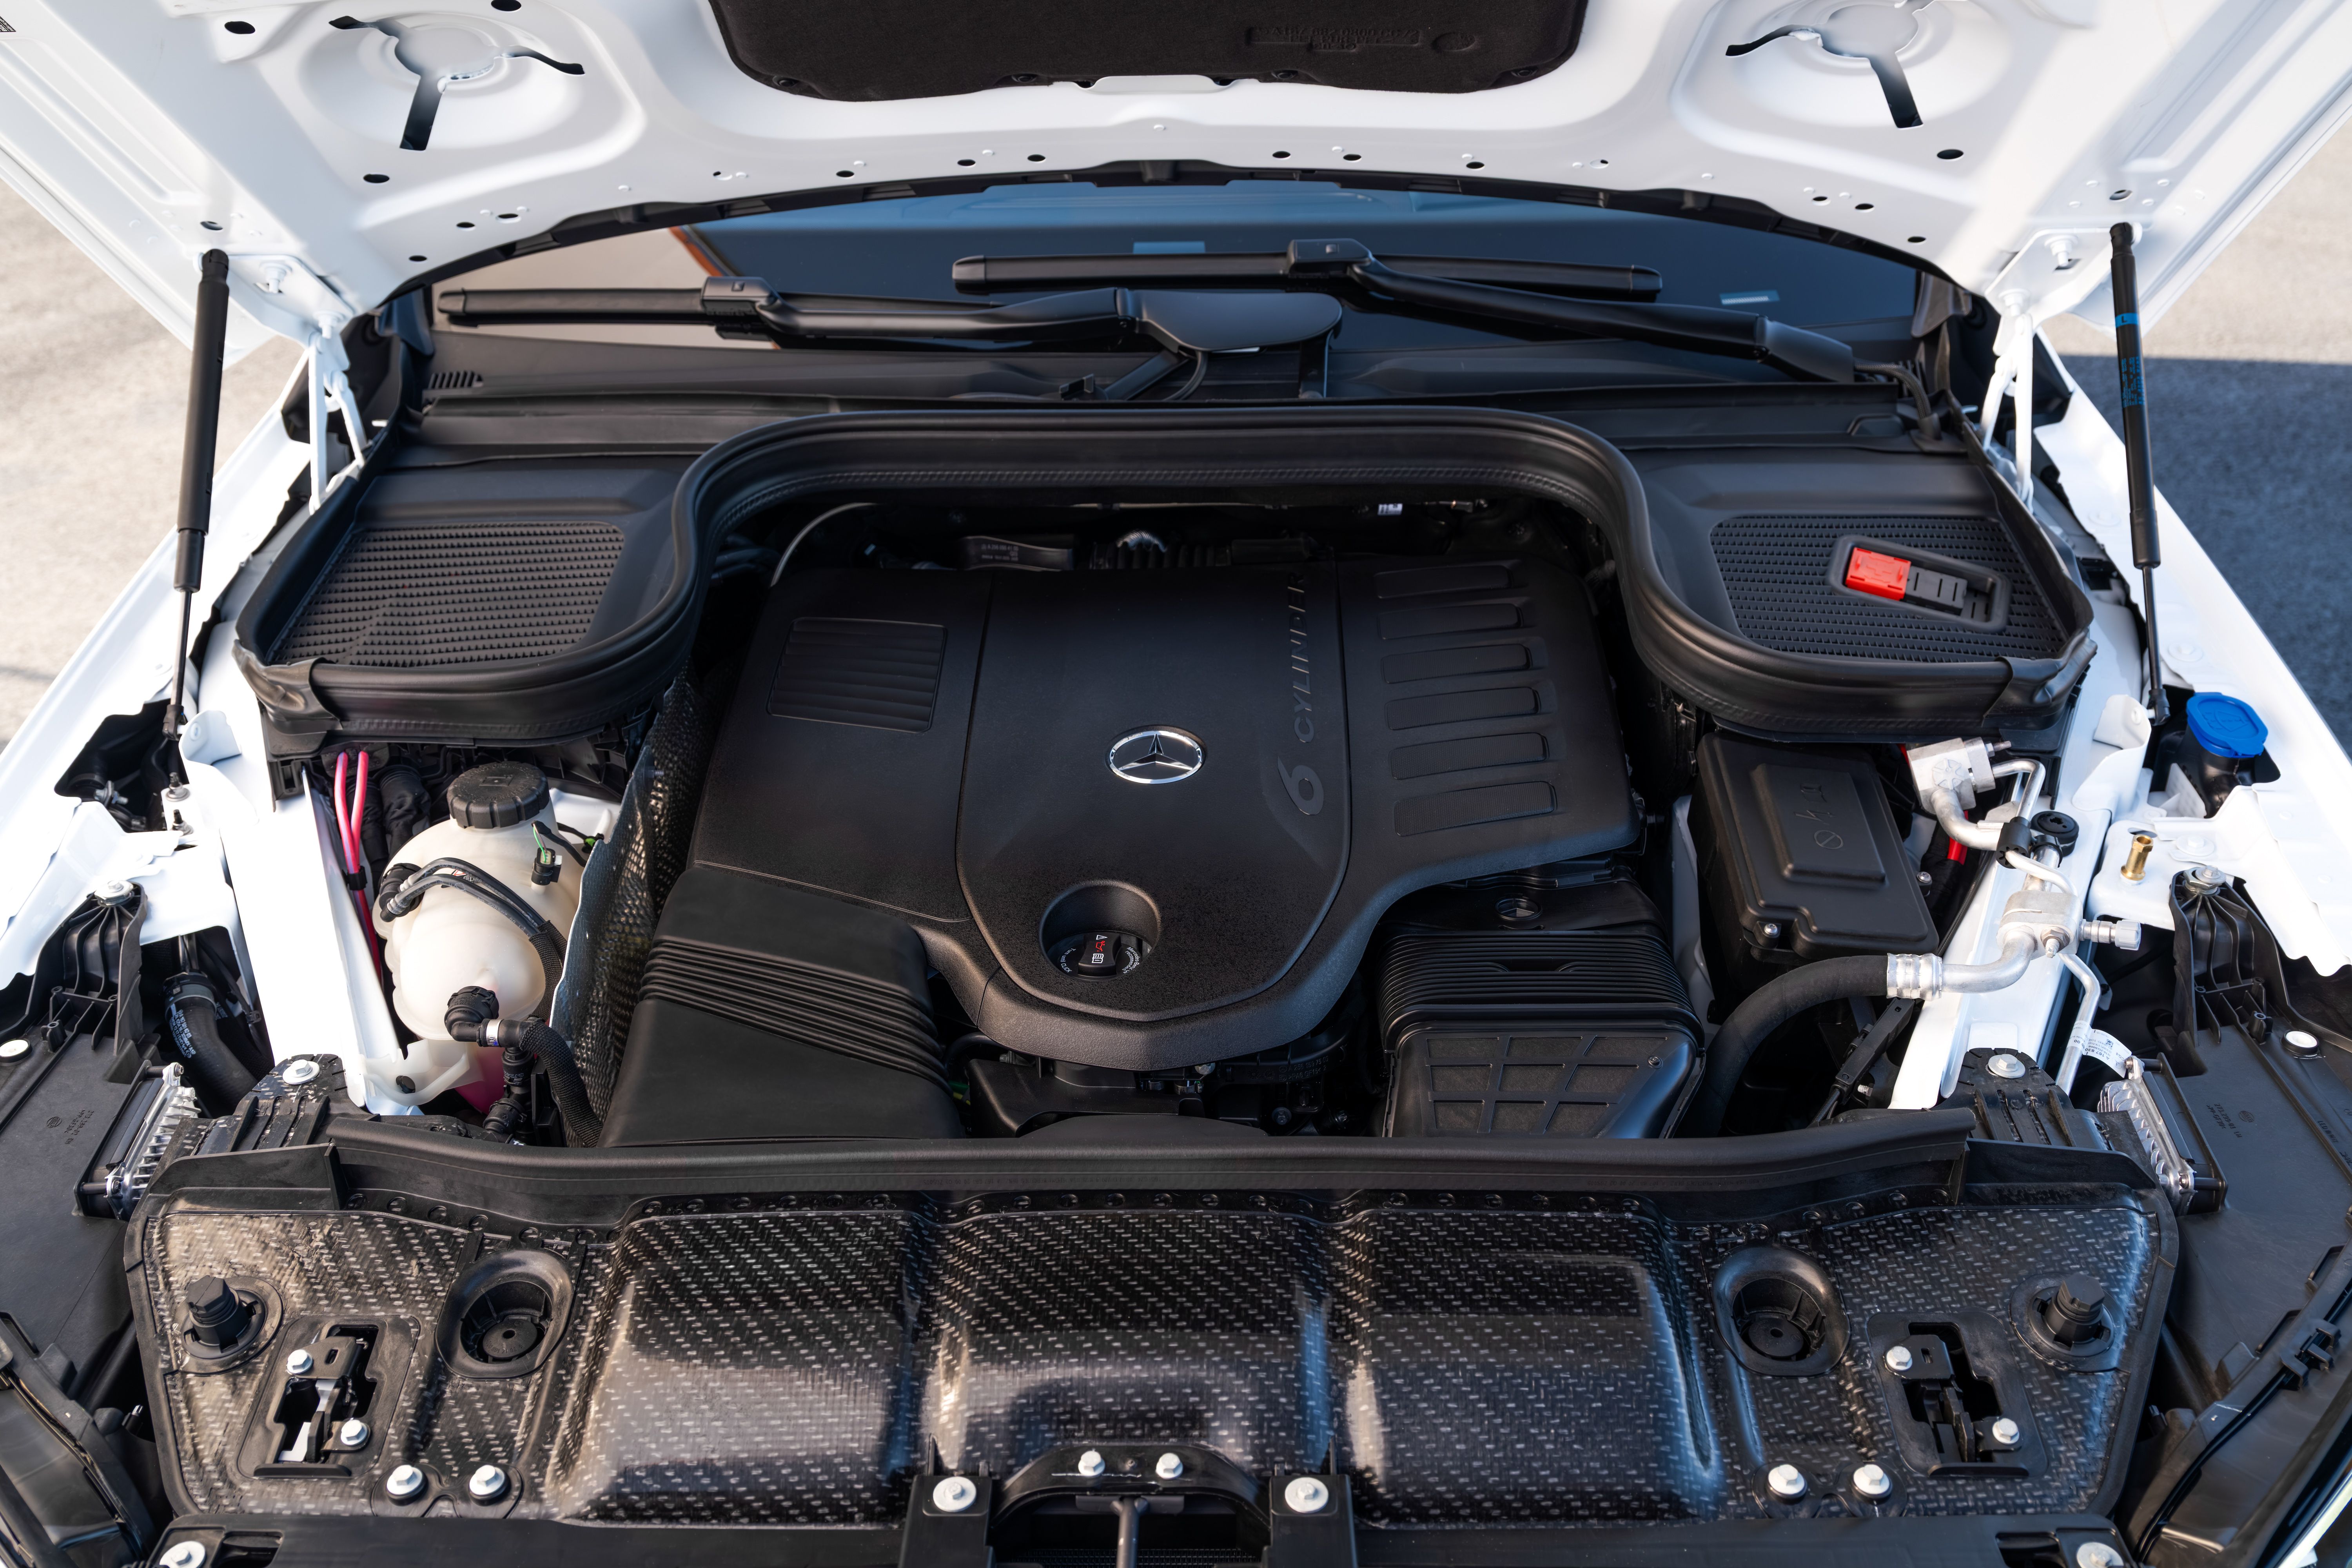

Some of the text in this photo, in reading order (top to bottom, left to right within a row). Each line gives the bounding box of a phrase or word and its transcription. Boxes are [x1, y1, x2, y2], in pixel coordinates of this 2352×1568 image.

[1287, 572, 1315, 743] CYLINDER
[1277, 756, 1325, 816] 6
[1061, 963, 1073, 973] CLICK
[1122, 951, 1134, 971] recommended
[1126, 947, 1140, 970] Mercedes-Benz
[2317, 1120, 2328, 1130] LED
